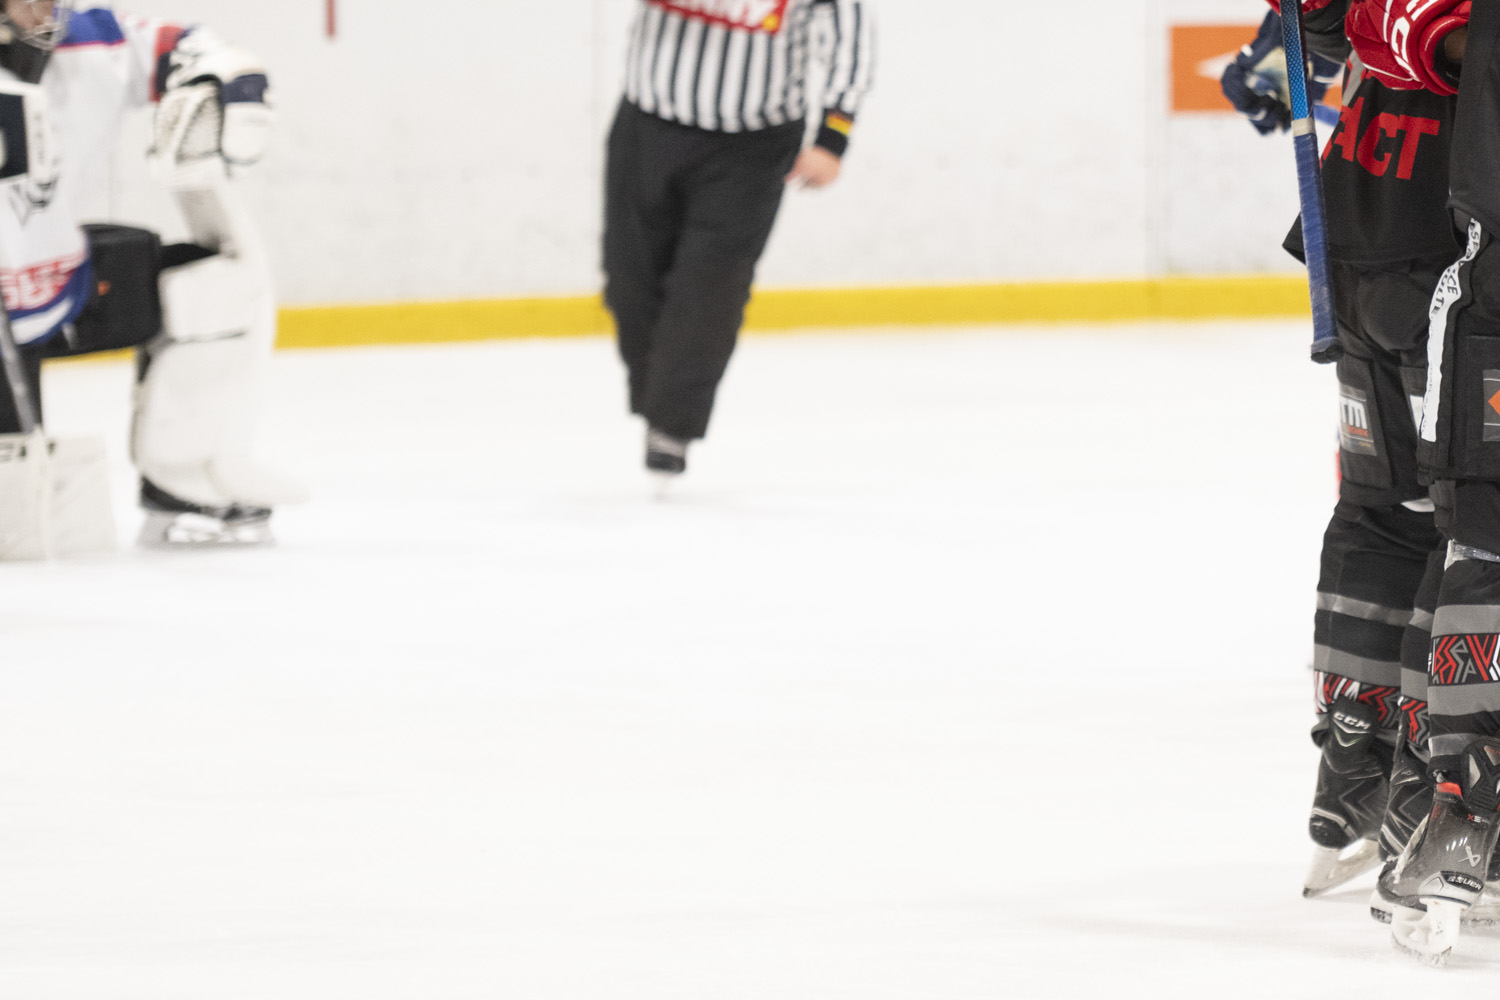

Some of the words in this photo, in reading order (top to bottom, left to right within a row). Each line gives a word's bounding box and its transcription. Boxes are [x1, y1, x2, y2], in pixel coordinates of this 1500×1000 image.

[1322, 96, 1440, 180] ACT
[1341, 397, 1368, 430] TM
[1333, 711, 1371, 730] CCM
